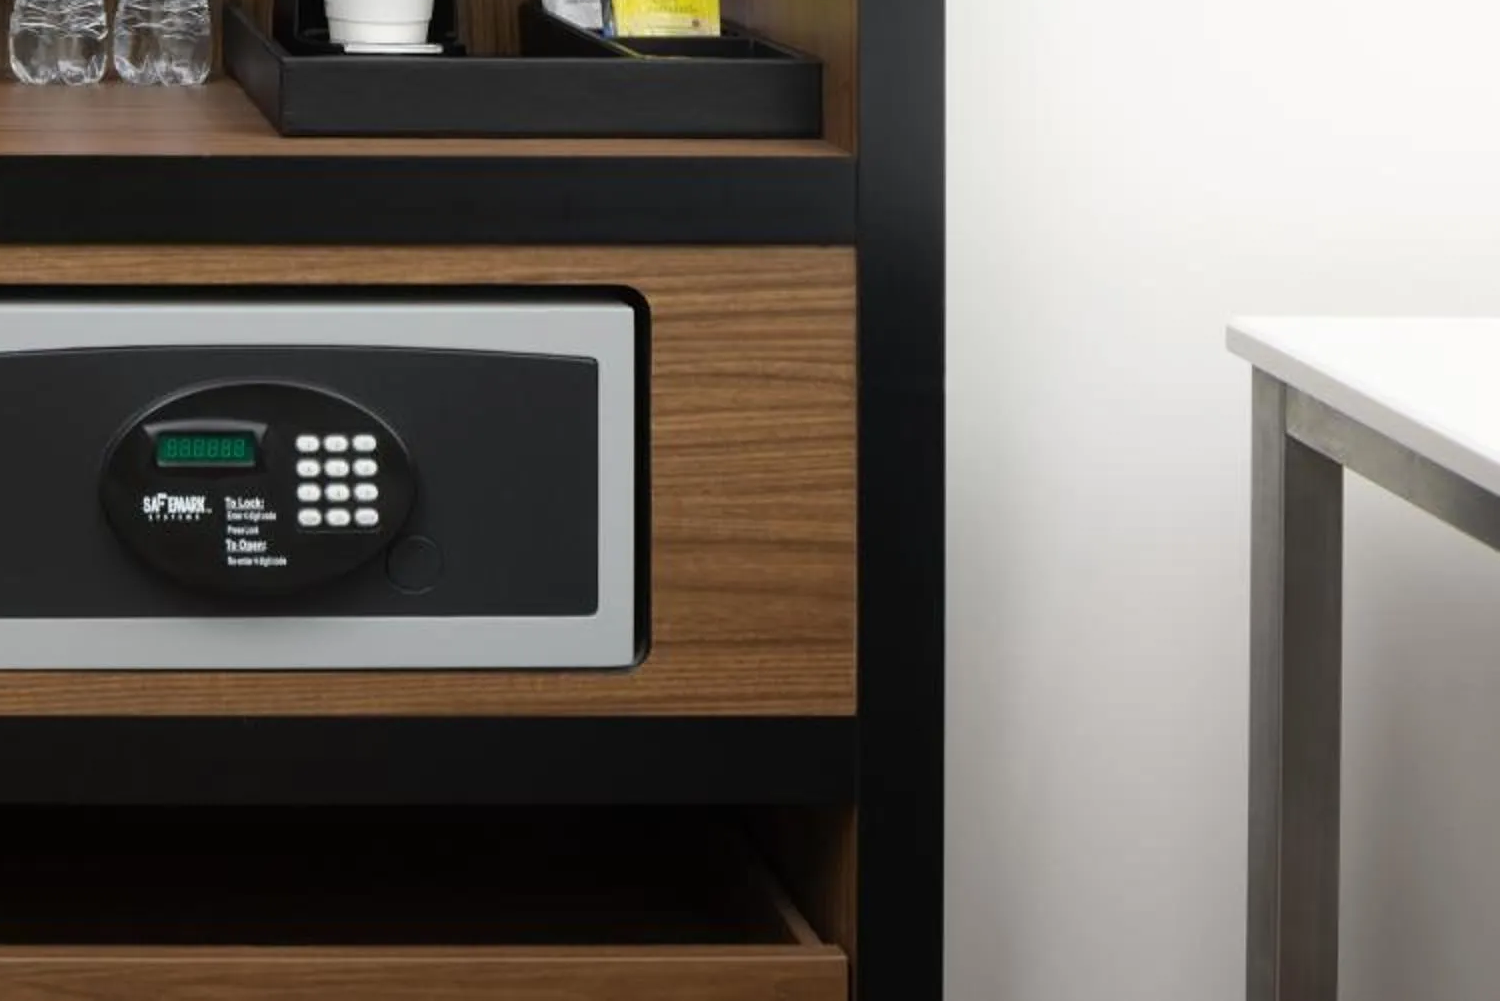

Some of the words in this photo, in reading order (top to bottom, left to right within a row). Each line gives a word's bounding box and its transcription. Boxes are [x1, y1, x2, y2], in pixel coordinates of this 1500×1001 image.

[143, 493, 205, 514] SAFEMARK
[225, 496, 237, 509] To
[238, 496, 265, 509] Lock:
[225, 538, 237, 552] To
[238, 538, 267, 553] Open:
